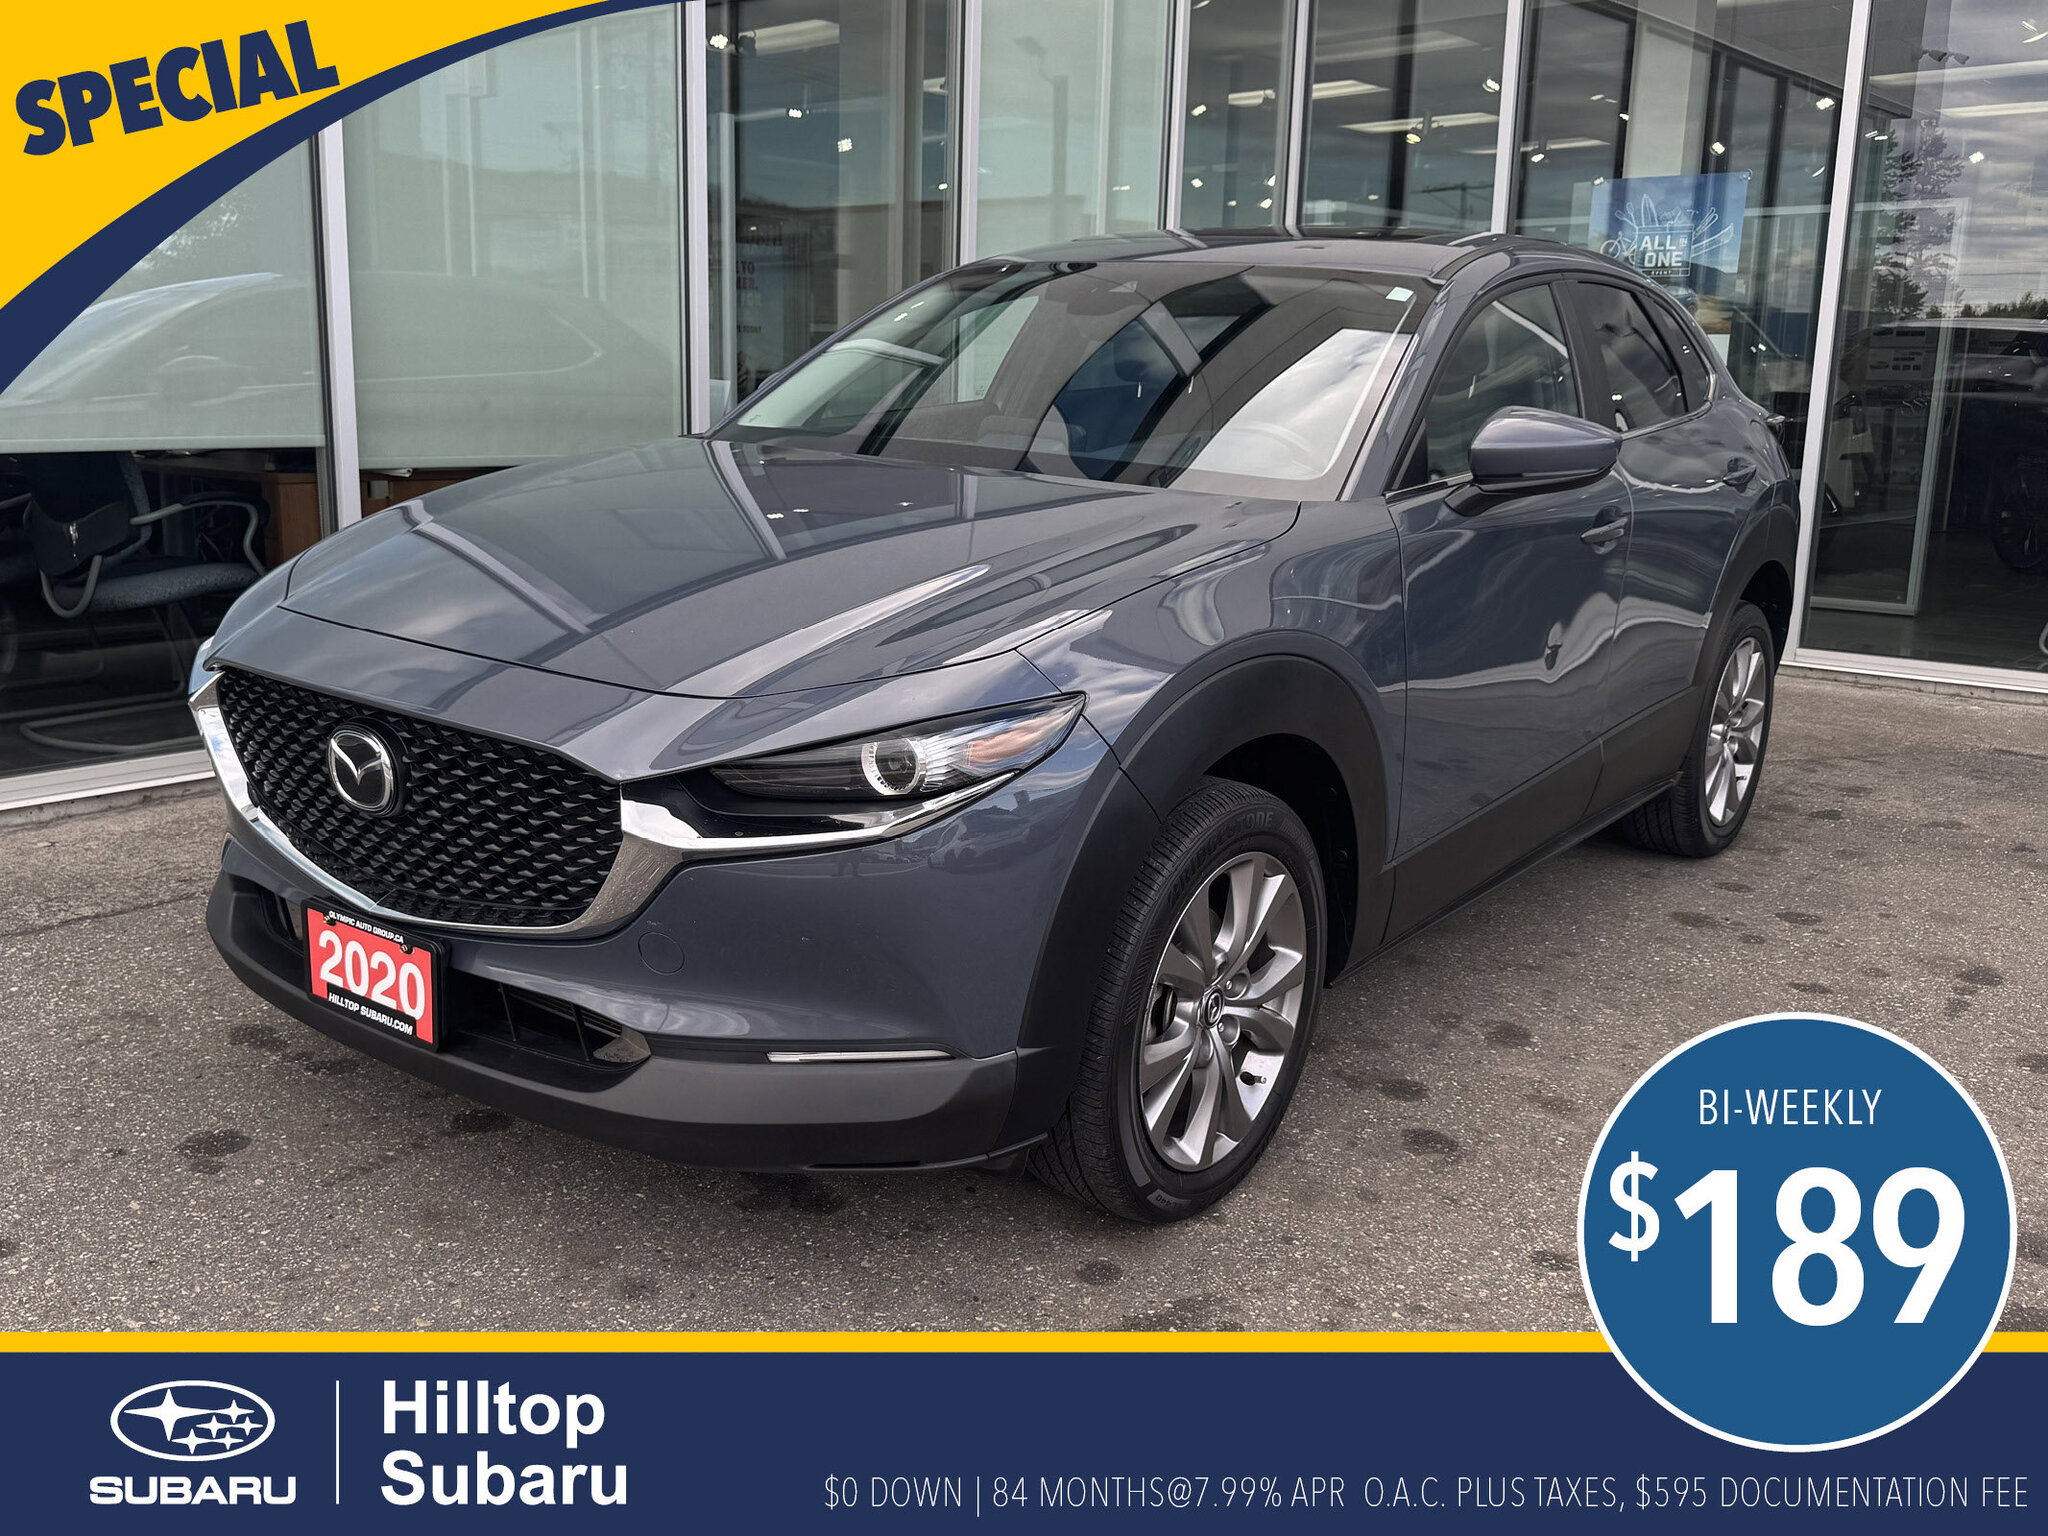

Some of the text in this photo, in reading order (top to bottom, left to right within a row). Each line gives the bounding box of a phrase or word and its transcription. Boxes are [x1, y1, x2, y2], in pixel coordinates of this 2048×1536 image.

[1640, 234, 1677, 250] ALL
[1644, 251, 1683, 267] ONE
[328, 910, 356, 926] OLYMPIC
[355, 920, 372, 932] AUTO
[319, 930, 425, 1020] 2020
[328, 992, 413, 1035] HILLTOP SUBARU.COM
